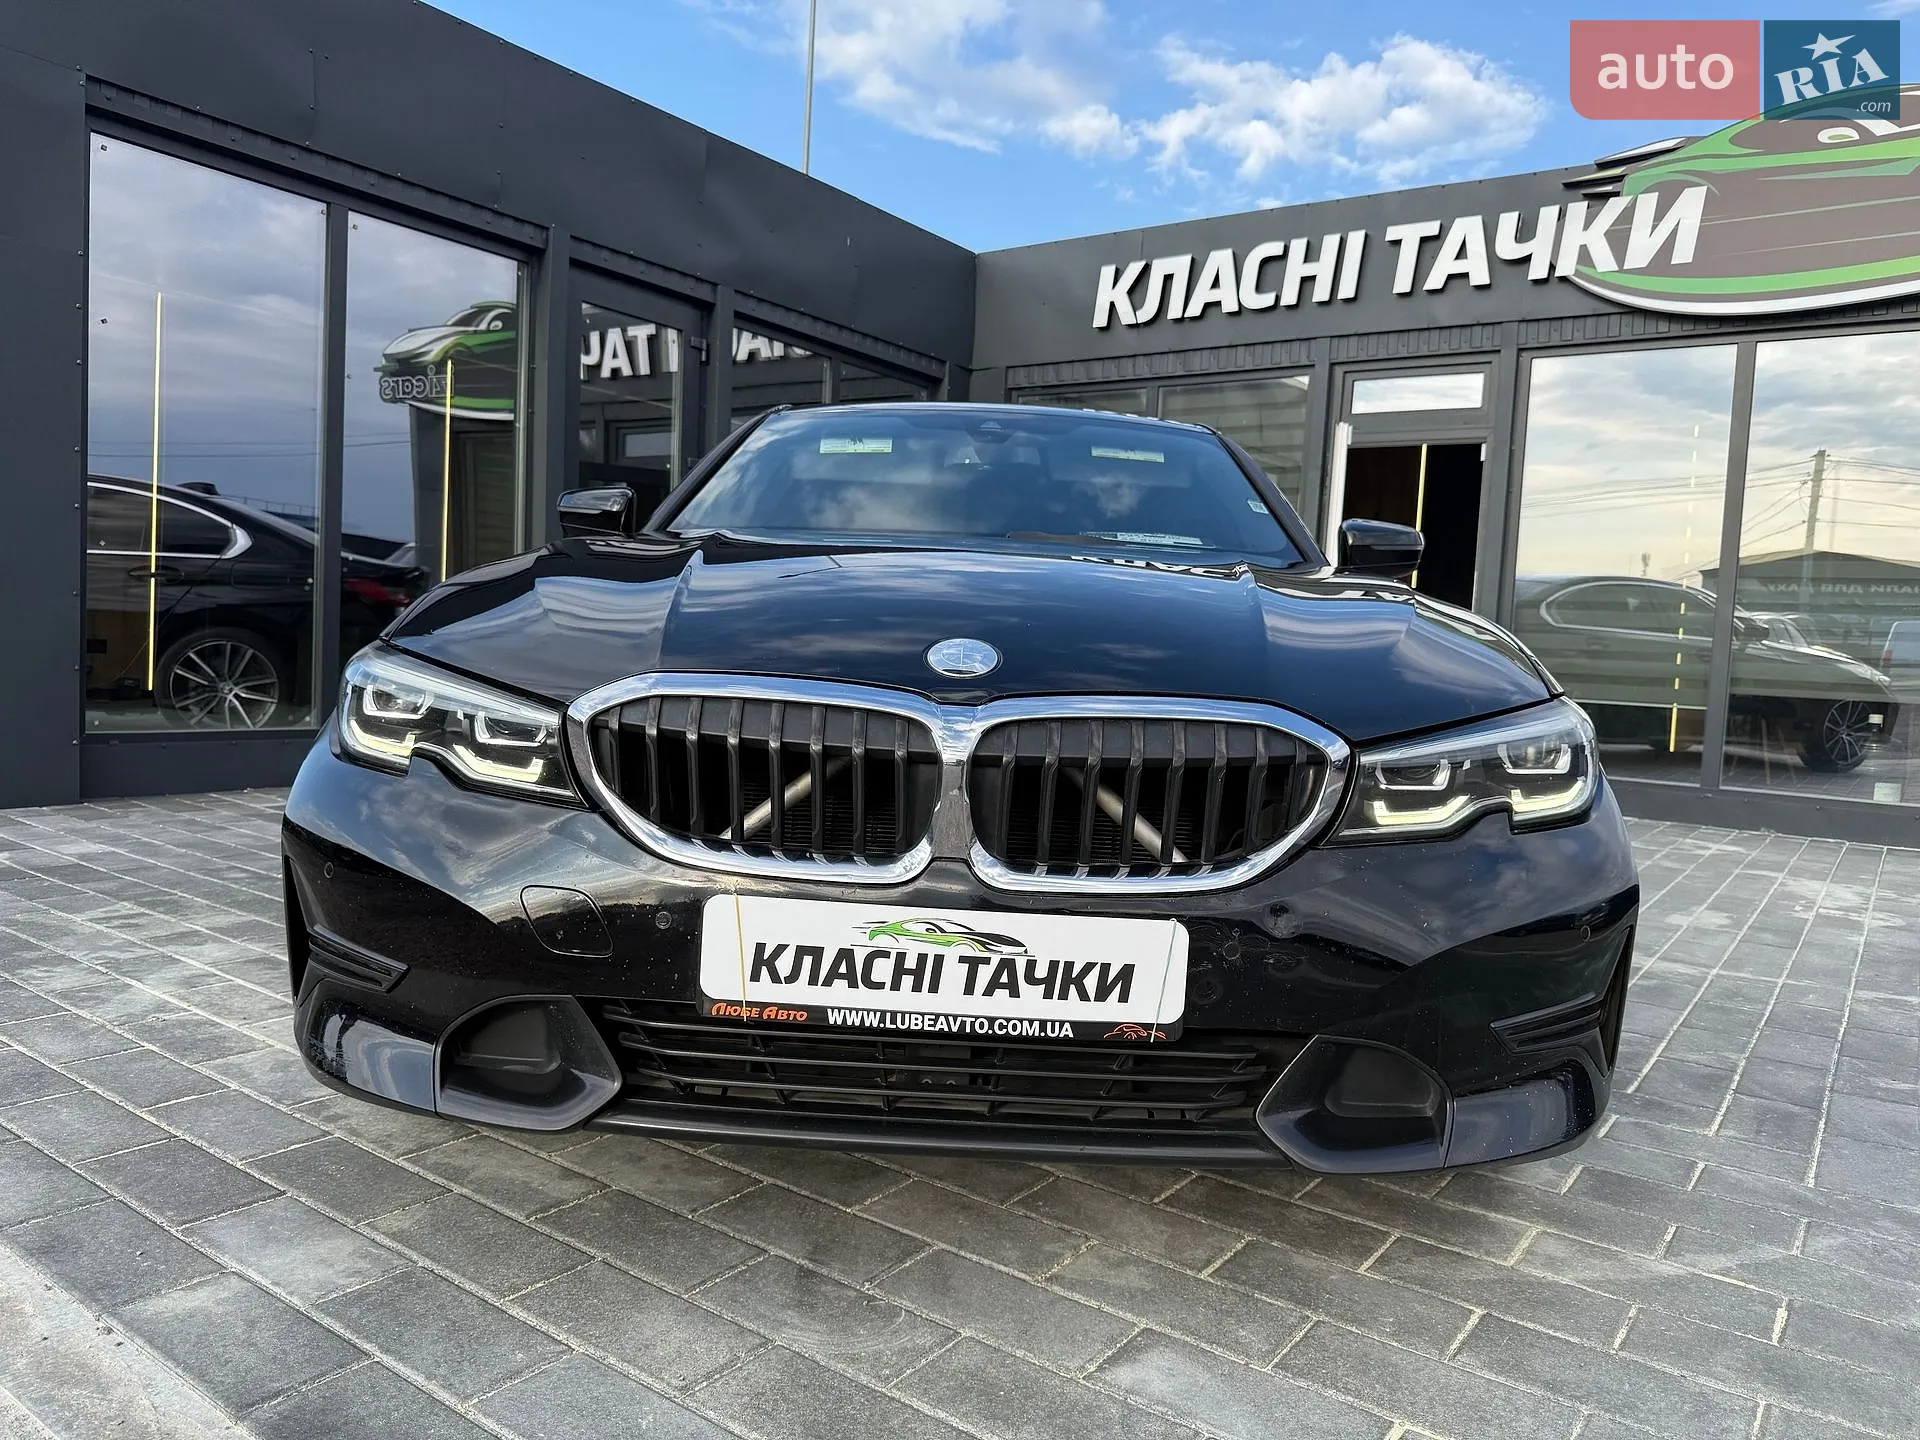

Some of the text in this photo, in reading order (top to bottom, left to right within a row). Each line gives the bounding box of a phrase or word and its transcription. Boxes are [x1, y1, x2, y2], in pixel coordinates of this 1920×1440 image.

[1092, 185, 1709, 328] КЛАСНІ ТАЧКИ
[750, 942, 1136, 1004] КЛАСНІ ТАЧКИ
[826, 1008, 1074, 1038] WWW.LUBEAVTO.COM.UA
